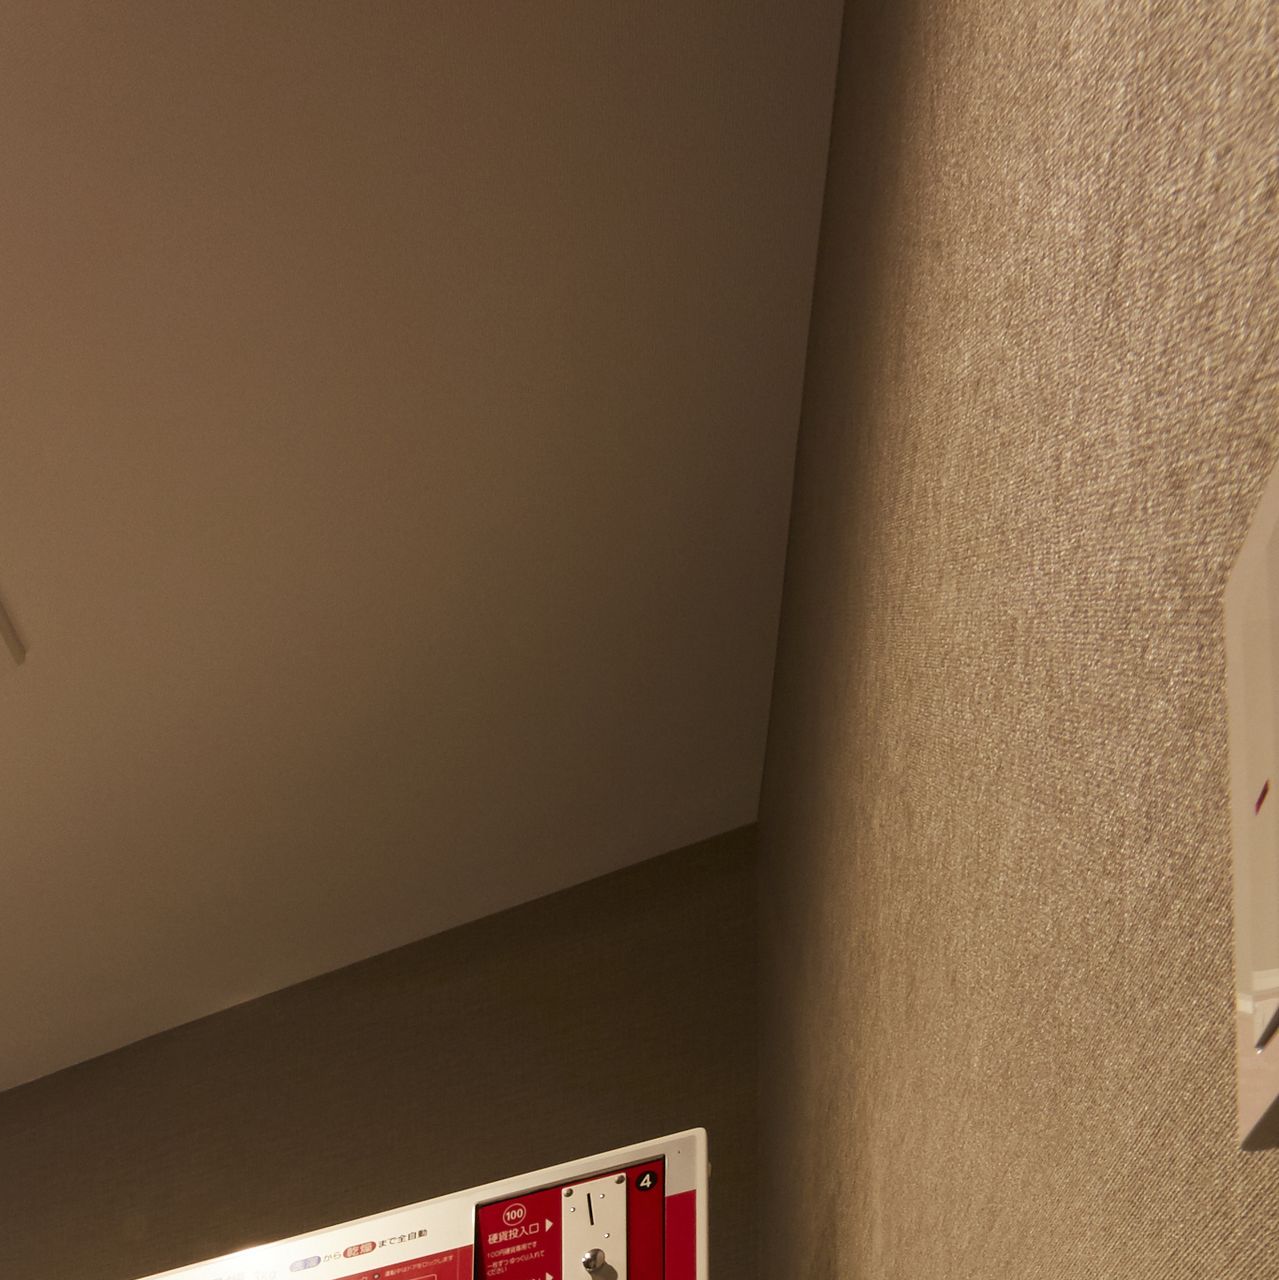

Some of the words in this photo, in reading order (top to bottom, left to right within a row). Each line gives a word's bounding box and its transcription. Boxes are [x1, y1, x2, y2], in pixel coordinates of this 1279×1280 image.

[638, 1173, 652, 1189] 4
[505, 1208, 524, 1221] 100
[487, 1223, 540, 1245] 硬貨投入口
